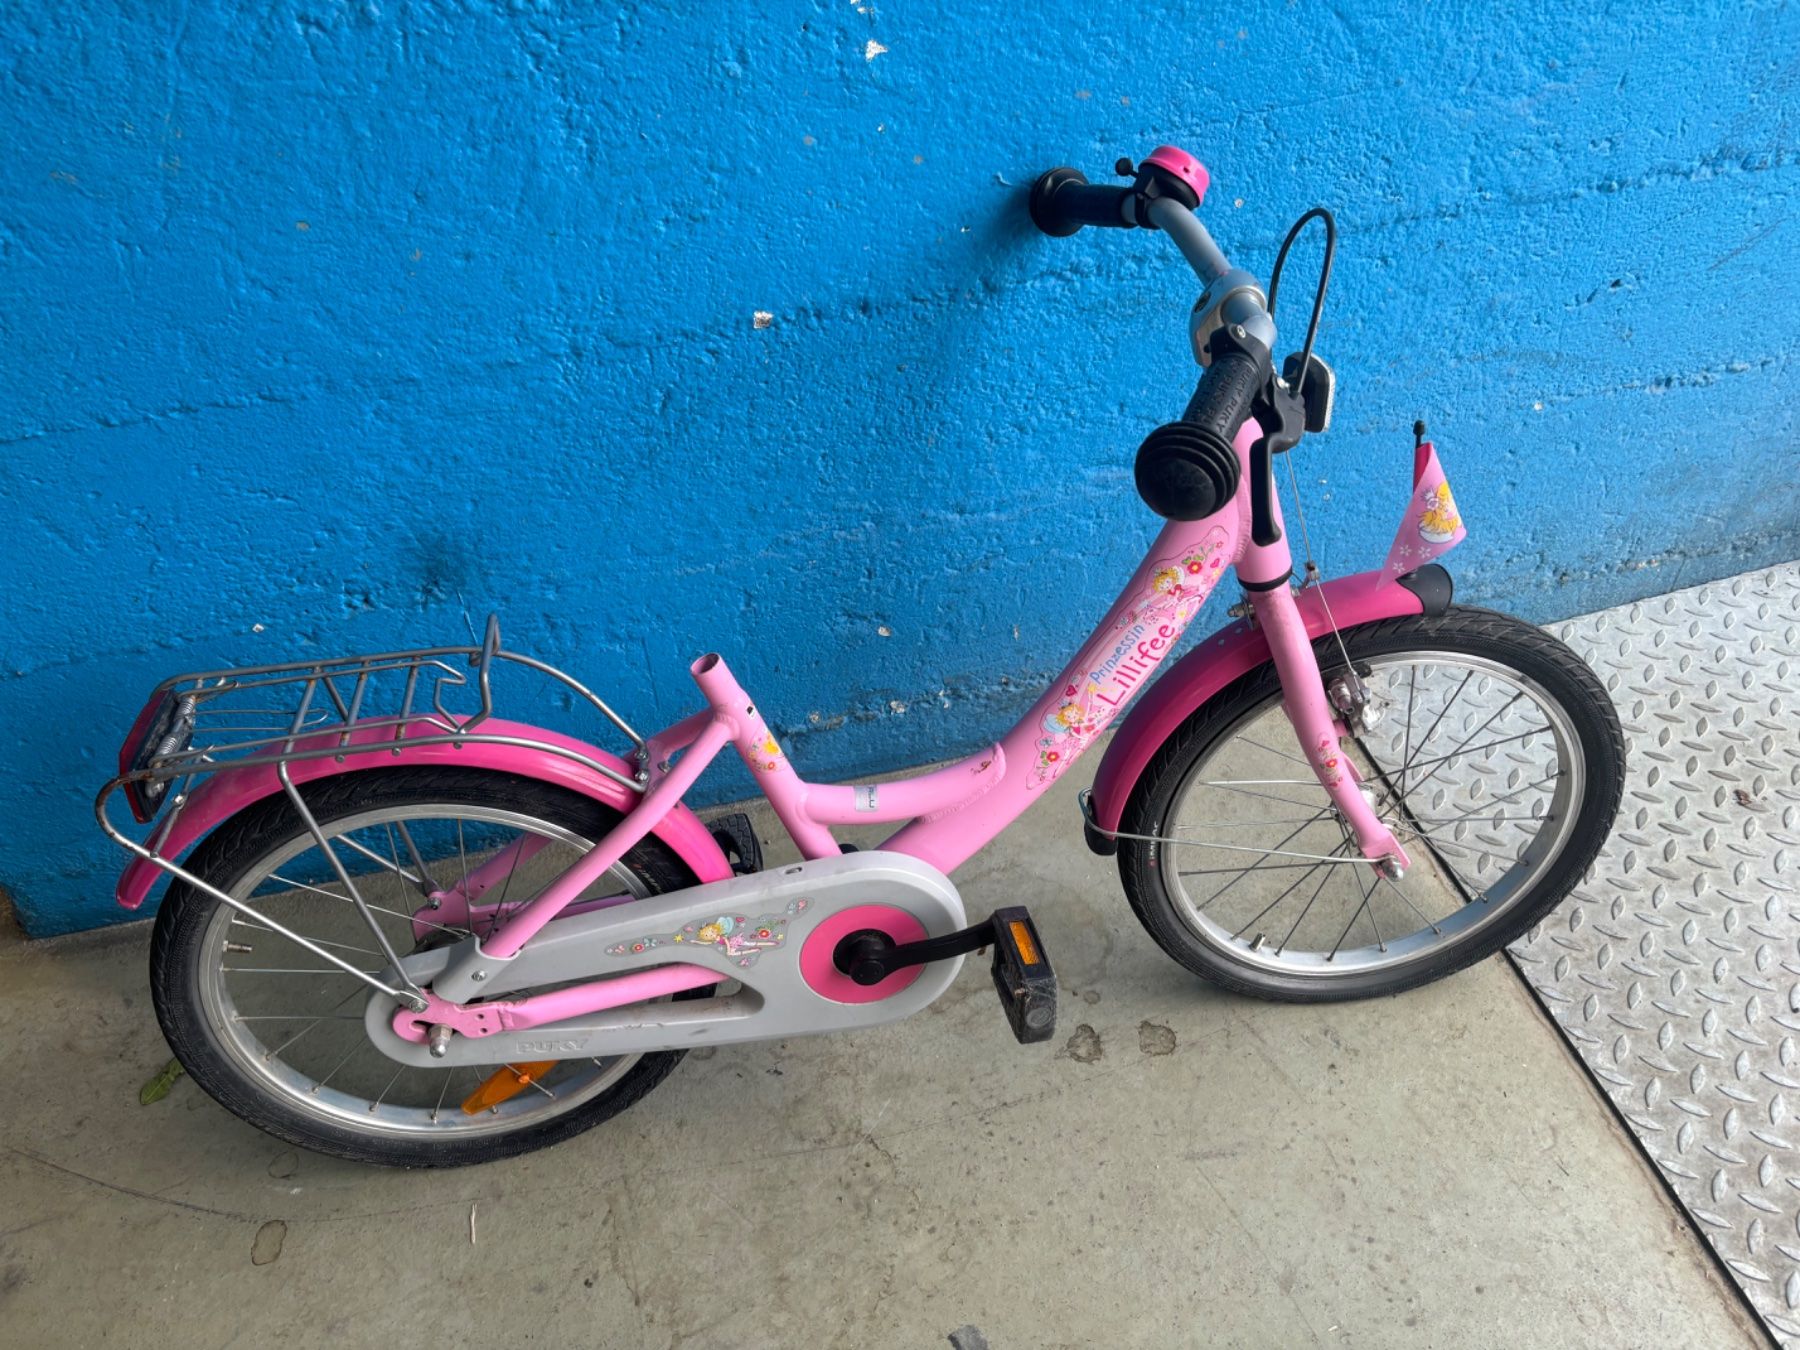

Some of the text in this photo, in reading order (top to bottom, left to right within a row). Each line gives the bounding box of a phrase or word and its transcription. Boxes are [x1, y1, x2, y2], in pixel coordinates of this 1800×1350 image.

[1215, 396, 1238, 433] PUKY
[1096, 623, 1176, 706] Lillifee
[515, 1038, 590, 1054] PUKY
